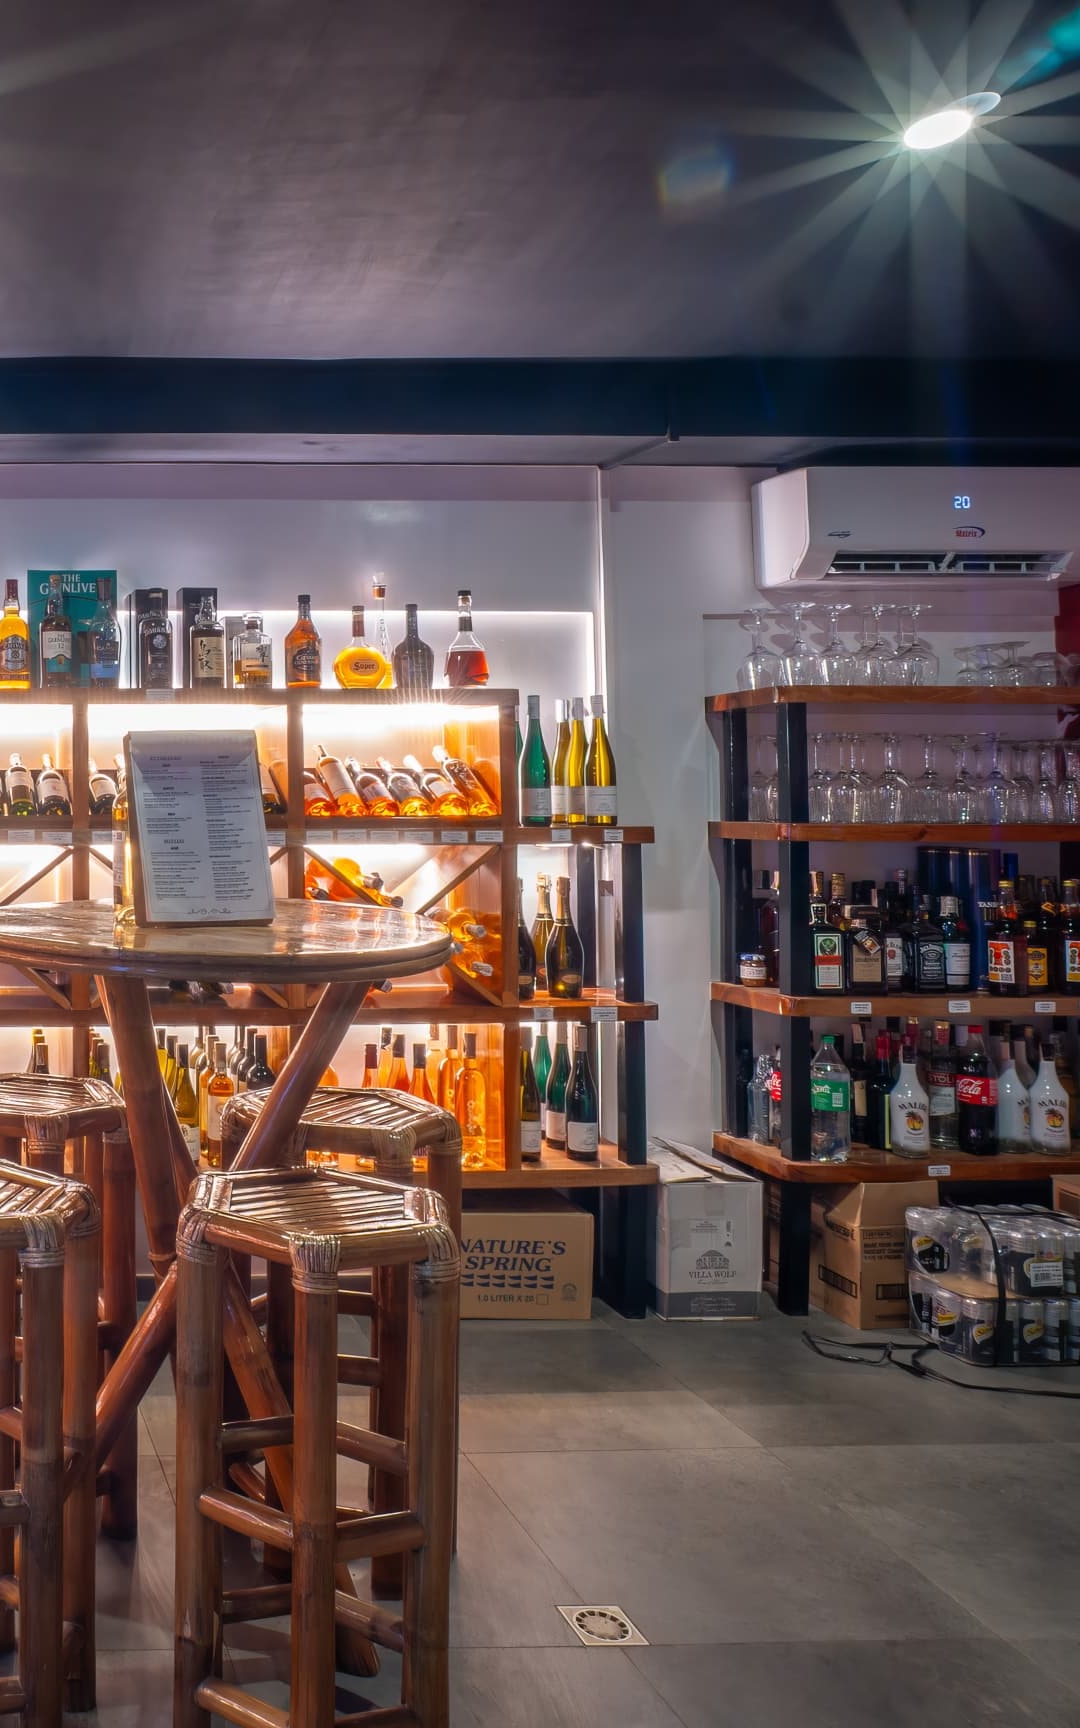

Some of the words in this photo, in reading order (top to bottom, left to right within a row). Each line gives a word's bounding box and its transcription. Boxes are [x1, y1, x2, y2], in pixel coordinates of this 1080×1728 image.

[953, 496, 971, 509] 20
[955, 529, 978, 539] Matrix
[62, 574, 81, 582] THE
[352, 661, 376, 672] Super
[460, 1239, 567, 1256] NATURE'S
[465, 1255, 552, 1272] SPRING
[688, 1271, 712, 1279] VILLA
[713, 1270, 737, 1279] WOLF
